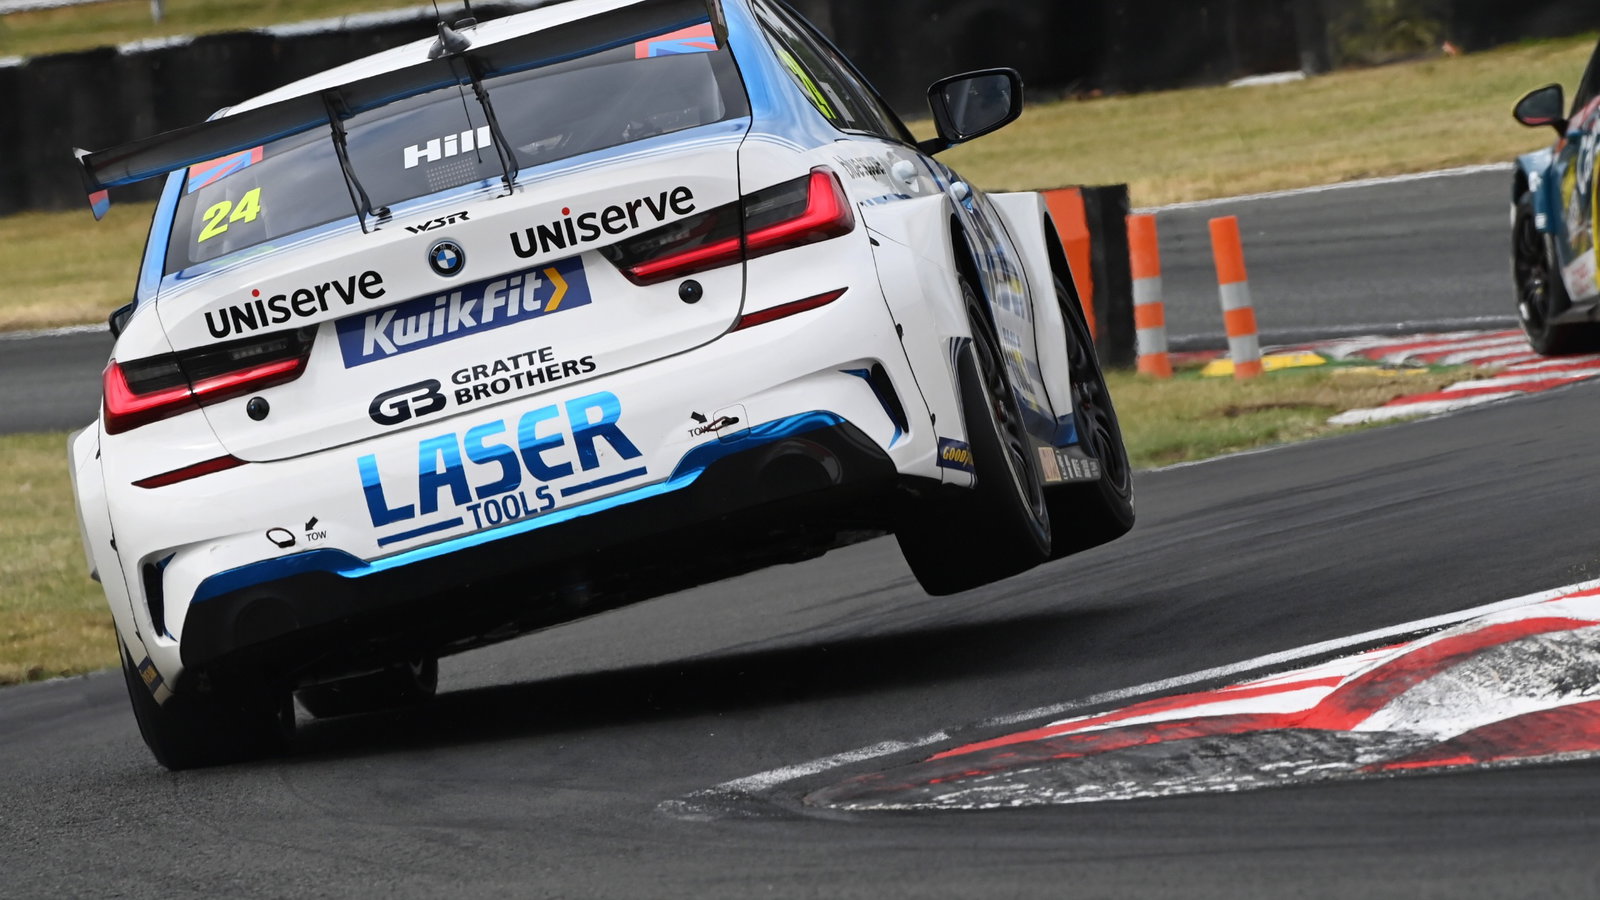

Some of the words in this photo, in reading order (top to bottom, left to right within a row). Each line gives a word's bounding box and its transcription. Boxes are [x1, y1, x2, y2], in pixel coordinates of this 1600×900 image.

[404, 125, 491, 169] Hill
[198, 187, 261, 242] 24
[404, 211, 471, 234] WSR
[451, 347, 555, 385] GRATTE
[454, 355, 597, 405] BROTHERS
[368, 378, 447, 425] GB
[357, 390, 643, 528] LASER
[466, 485, 556, 528] TOOLS
[306, 530, 327, 541] TOW
